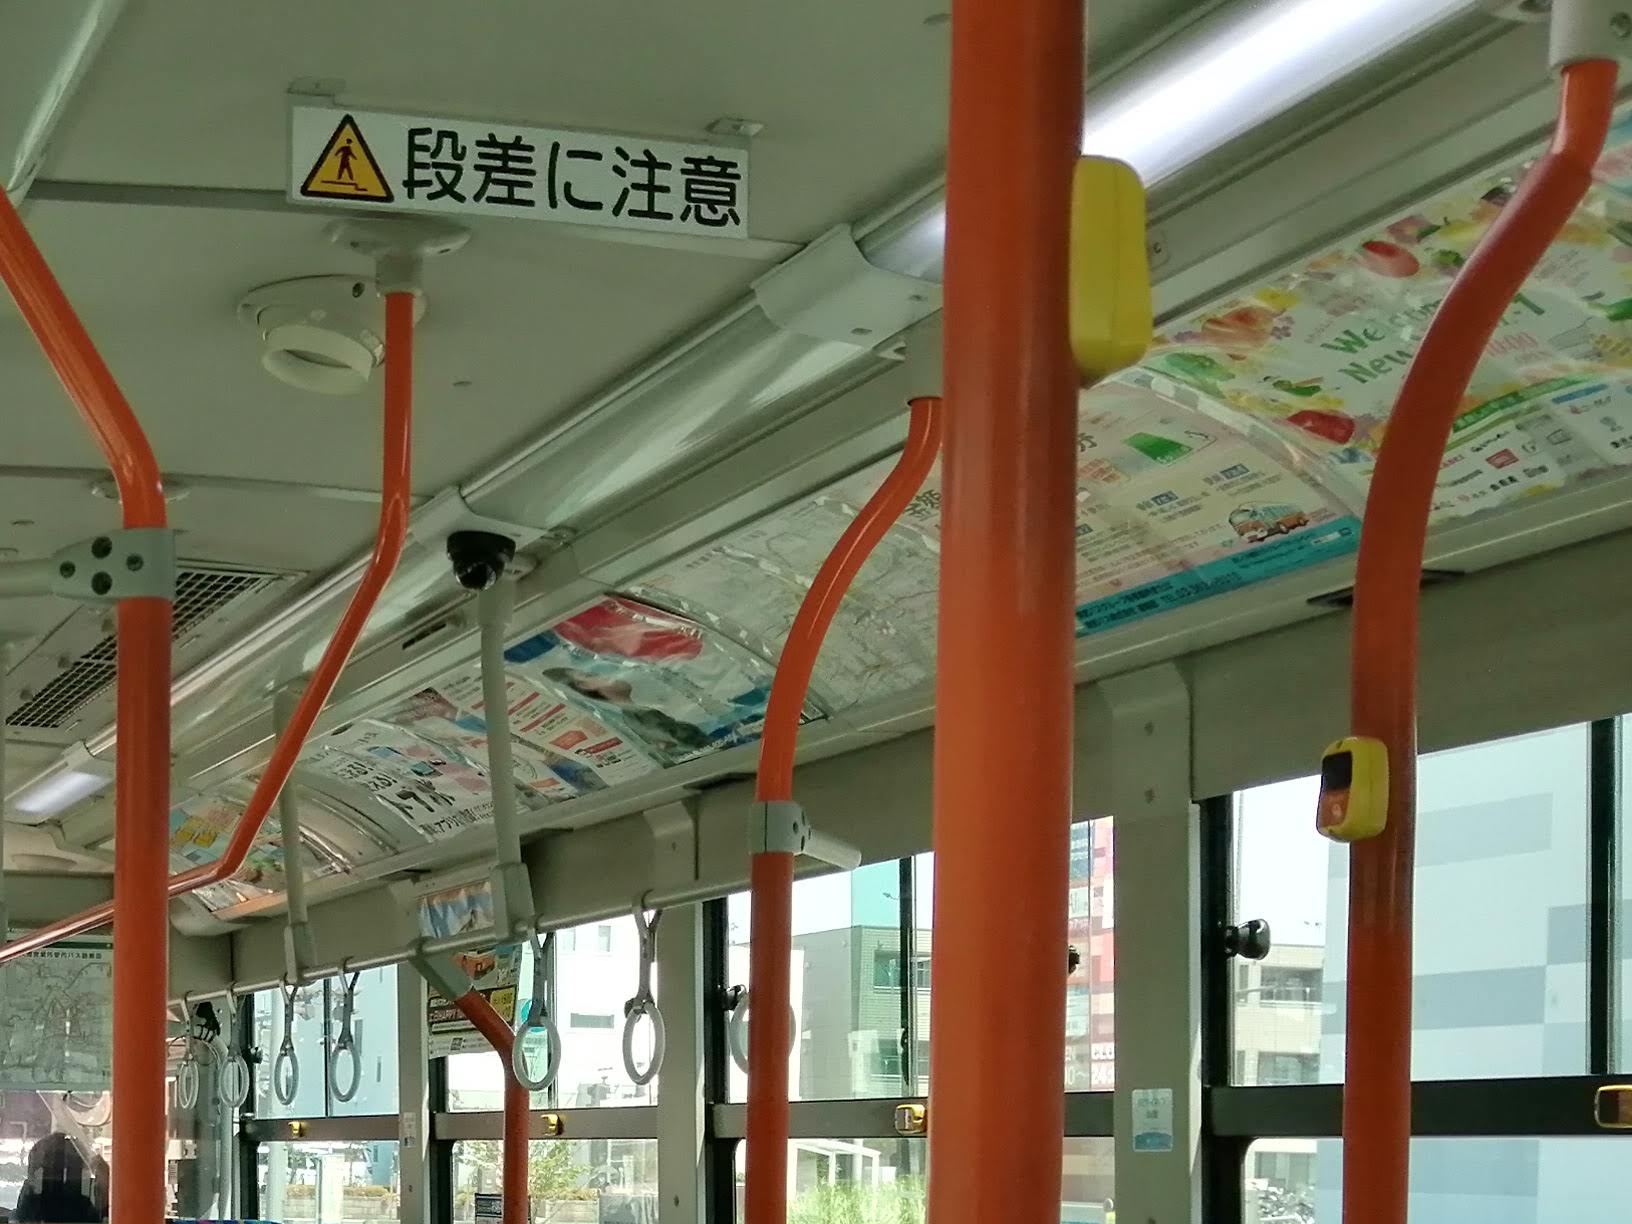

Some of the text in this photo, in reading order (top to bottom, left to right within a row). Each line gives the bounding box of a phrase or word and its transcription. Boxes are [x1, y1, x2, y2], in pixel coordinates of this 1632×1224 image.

[402, 127, 743, 227] 段差に注意
